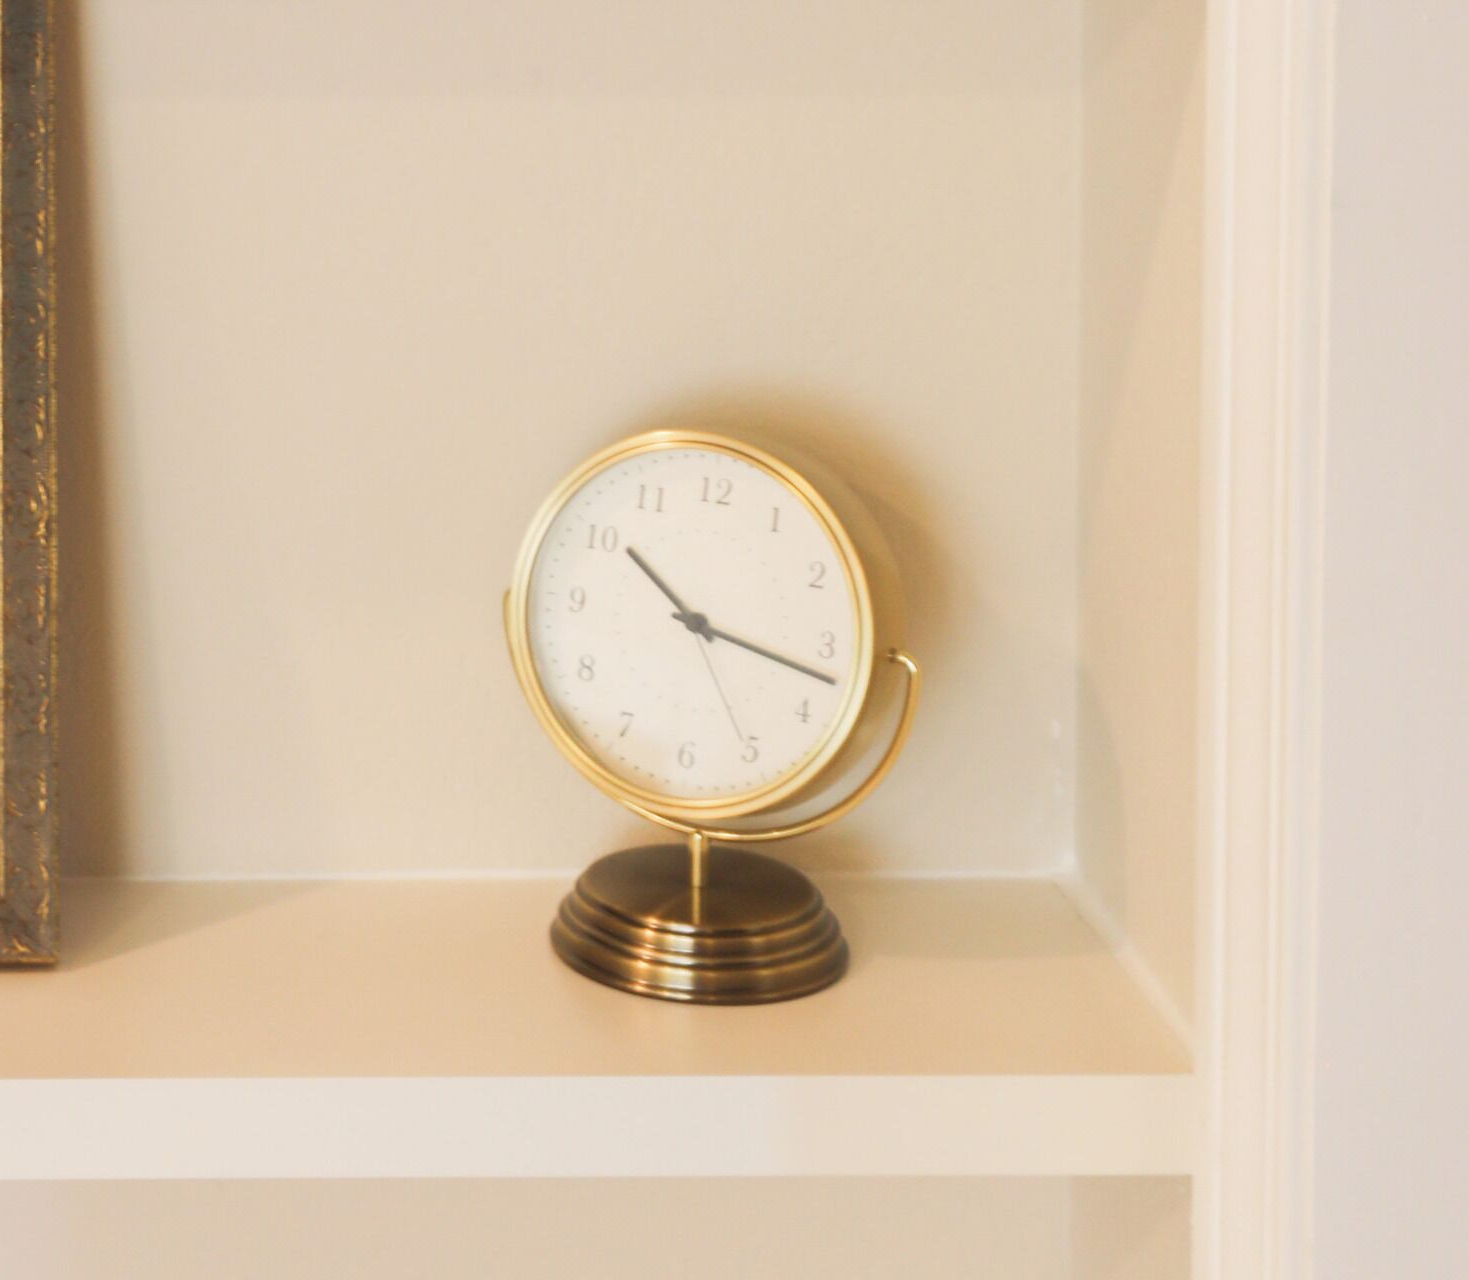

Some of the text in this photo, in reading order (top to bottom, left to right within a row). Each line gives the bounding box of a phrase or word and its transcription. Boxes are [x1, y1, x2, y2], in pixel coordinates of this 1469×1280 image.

[637, 483, 666, 513] 11
[700, 476, 733, 505] 12
[770, 507, 781, 533] 1
[586, 524, 619, 553] 10
[808, 561, 827, 589] 2
[568, 587, 586, 612] 9
[817, 631, 836, 659] 3
[578, 654, 596, 681] 8
[618, 711, 635, 737] 7
[795, 699, 812, 724] 4
[678, 741, 696, 769] 6
[741, 735, 760, 763] 5
